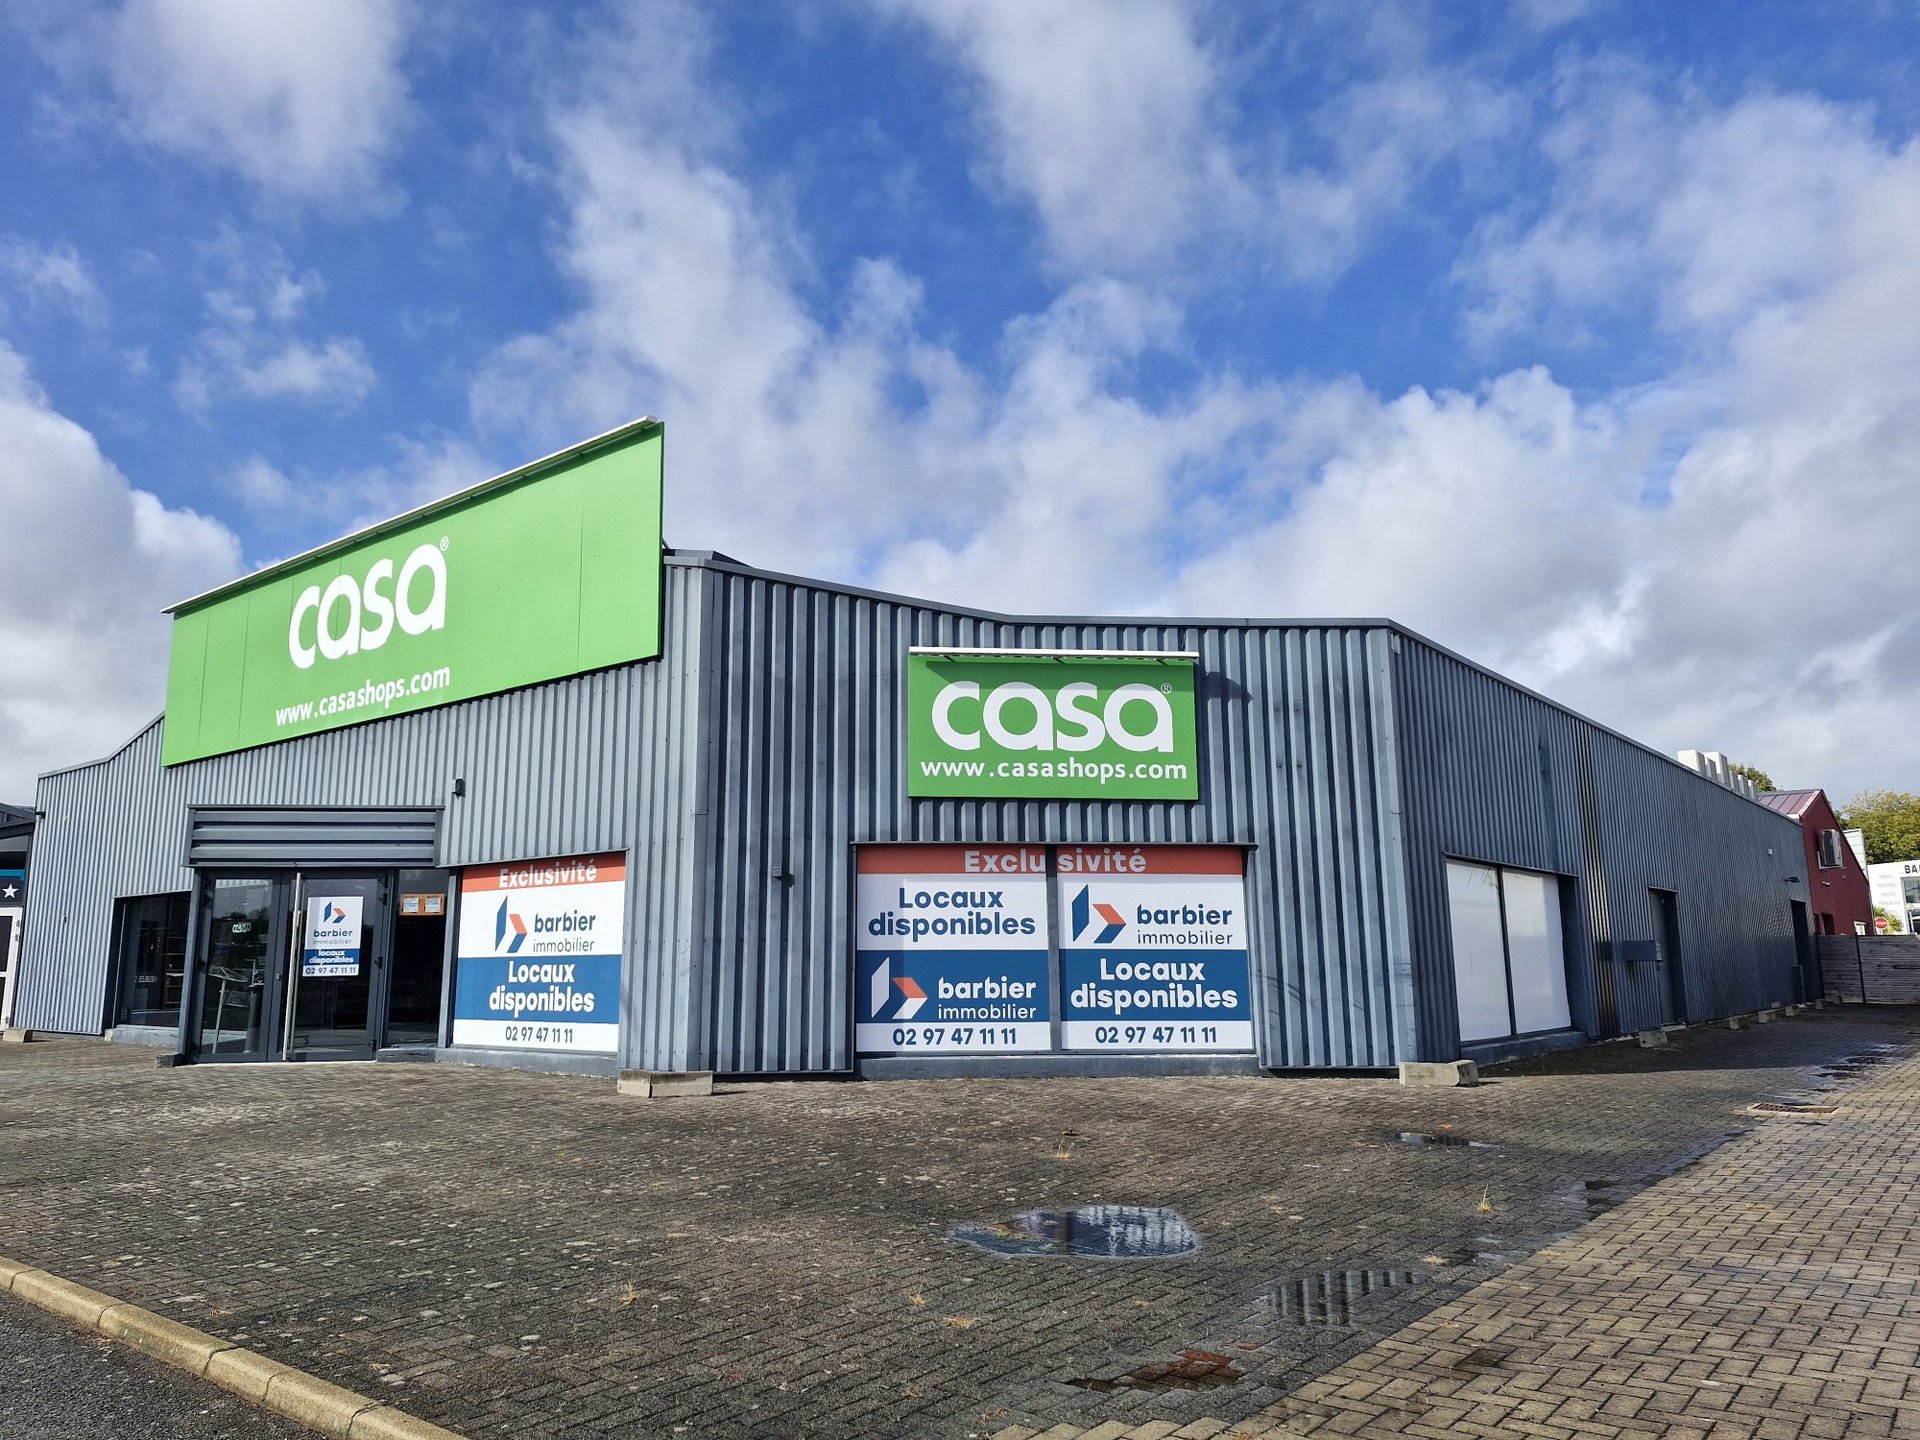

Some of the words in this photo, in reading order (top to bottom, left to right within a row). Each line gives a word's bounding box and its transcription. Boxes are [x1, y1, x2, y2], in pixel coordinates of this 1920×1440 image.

[288, 543, 447, 669] casa
[275, 666, 450, 726] www.casashops.com
[931, 680, 1174, 752] casa
[920, 757, 1187, 784] www.casashops.com
[499, 858, 597, 888] Exclusivité
[899, 887, 1004, 909] Locaux
[534, 909, 596, 933] barbier
[1137, 903, 1233, 926] barbier
[313, 928, 353, 938] barbier
[868, 911, 1036, 942] disponibles
[1137, 930, 1233, 945] immobilier
[533, 937, 595, 953] immobilier
[305, 967, 316, 975] 02
[309, 956, 354, 965] disponibles
[508, 960, 575, 983] Locaux
[1100, 958, 1206, 981] Locaux
[938, 975, 1037, 999] barbier
[489, 985, 595, 1018] disponibles
[1070, 983, 1238, 1015] disponibles
[938, 1003, 1037, 1020] immobilier
[505, 1026, 518, 1041] 02
[521, 1026, 533, 1042] 97
[536, 1027, 549, 1042] 47
[552, 1028, 561, 1043] 11
[564, 1028, 573, 1043] 11
[892, 1028, 917, 1046] 02
[923, 1028, 945, 1046] 97
[951, 1028, 974, 1045] 47
[979, 1028, 995, 1045] 11
[1000, 1028, 1017, 1045] 11
[1095, 1026, 1119, 1044] 02
[1125, 1026, 1147, 1043] 97
[1152, 1027, 1175, 1043] 47
[1180, 1027, 1196, 1043] 11
[1201, 1027, 1217, 1043] 11
